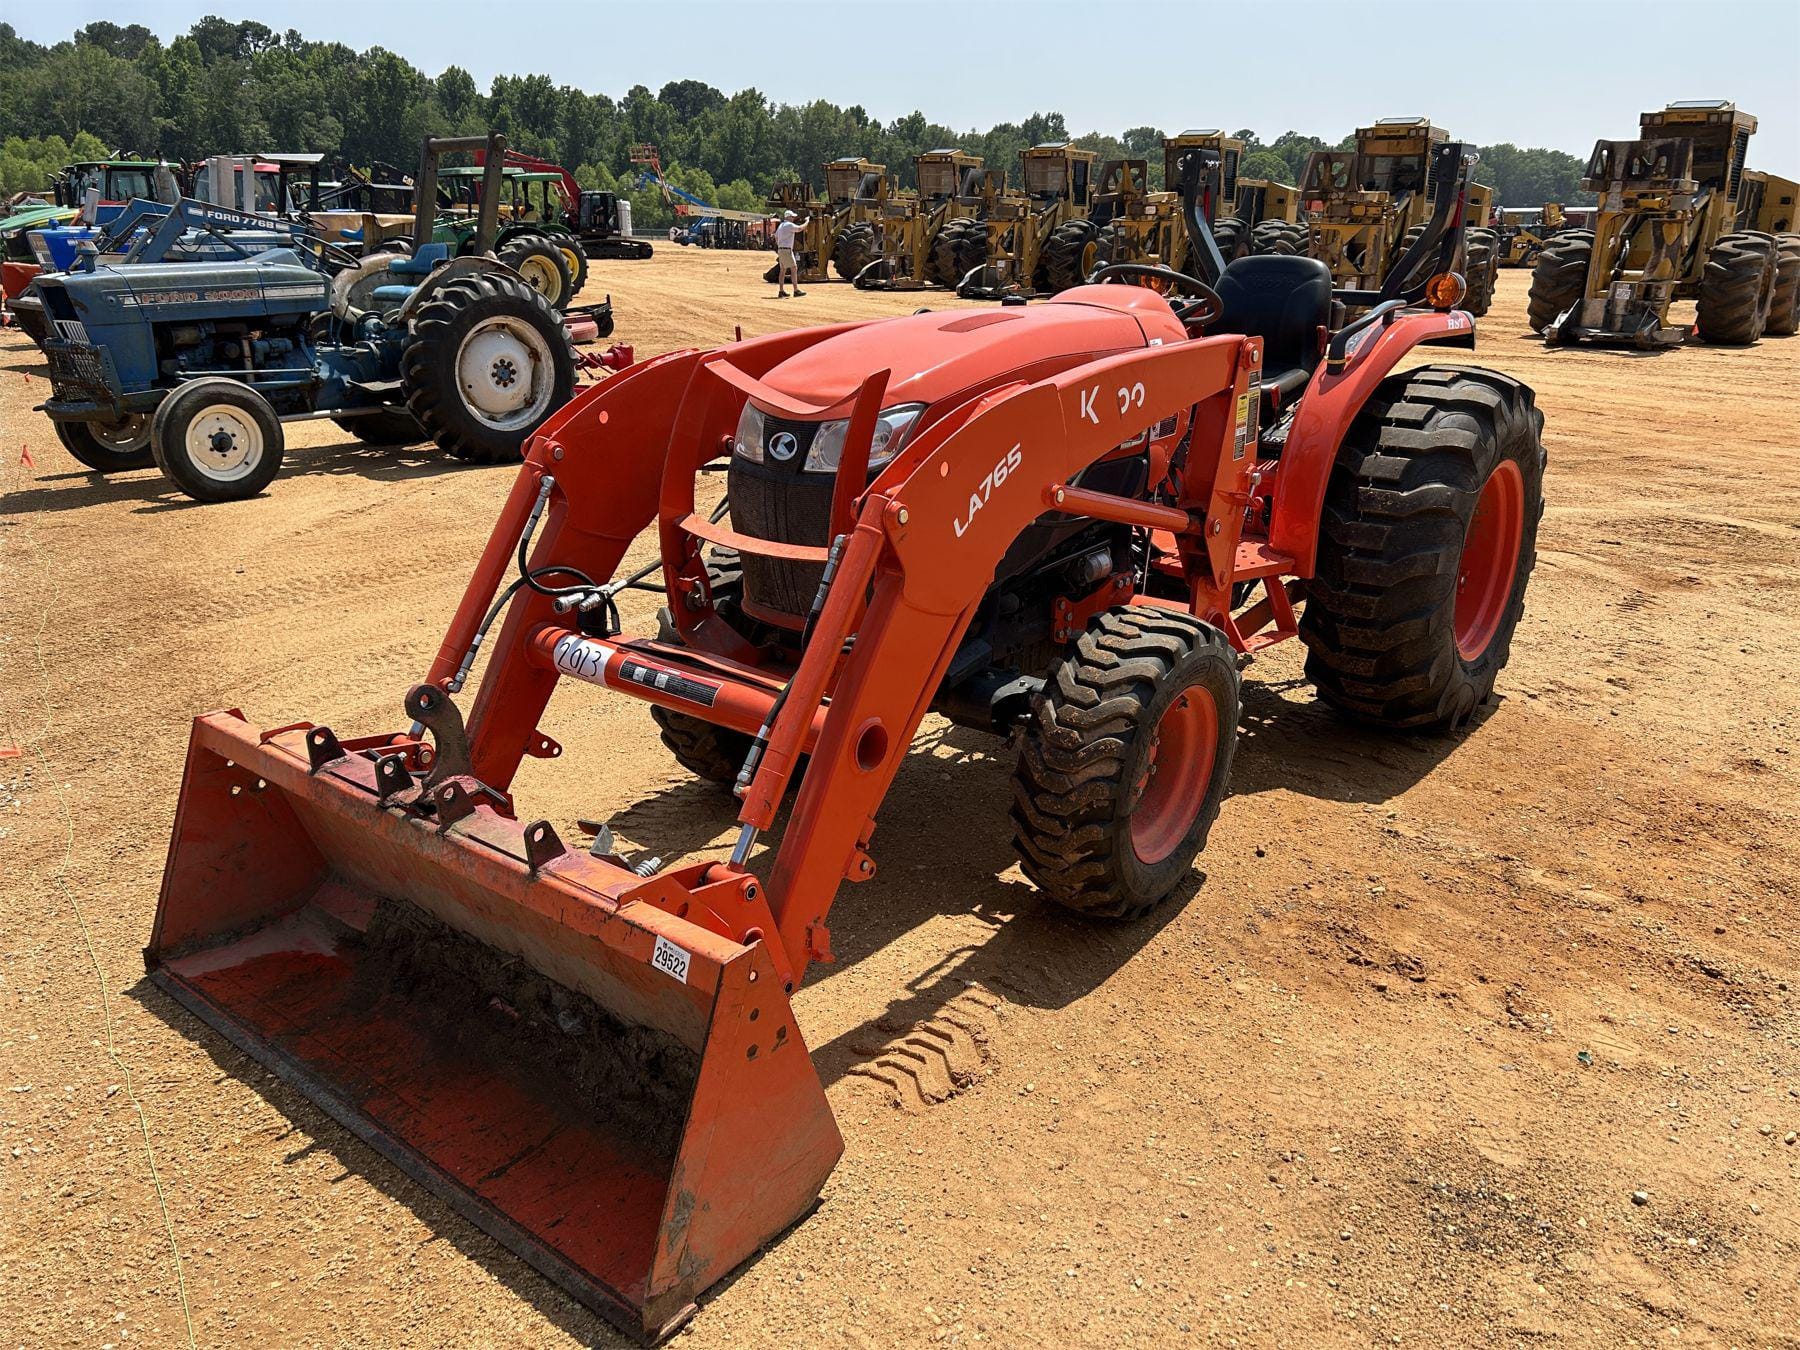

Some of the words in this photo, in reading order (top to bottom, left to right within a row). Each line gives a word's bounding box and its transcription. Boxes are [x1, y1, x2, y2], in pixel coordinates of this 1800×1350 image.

[207, 210, 240, 223] FORD
[242, 217, 275, 229] 776B
[142, 292, 198, 303] FORD
[953, 442, 1022, 538] LA765
[655, 946, 686, 978] 29522
